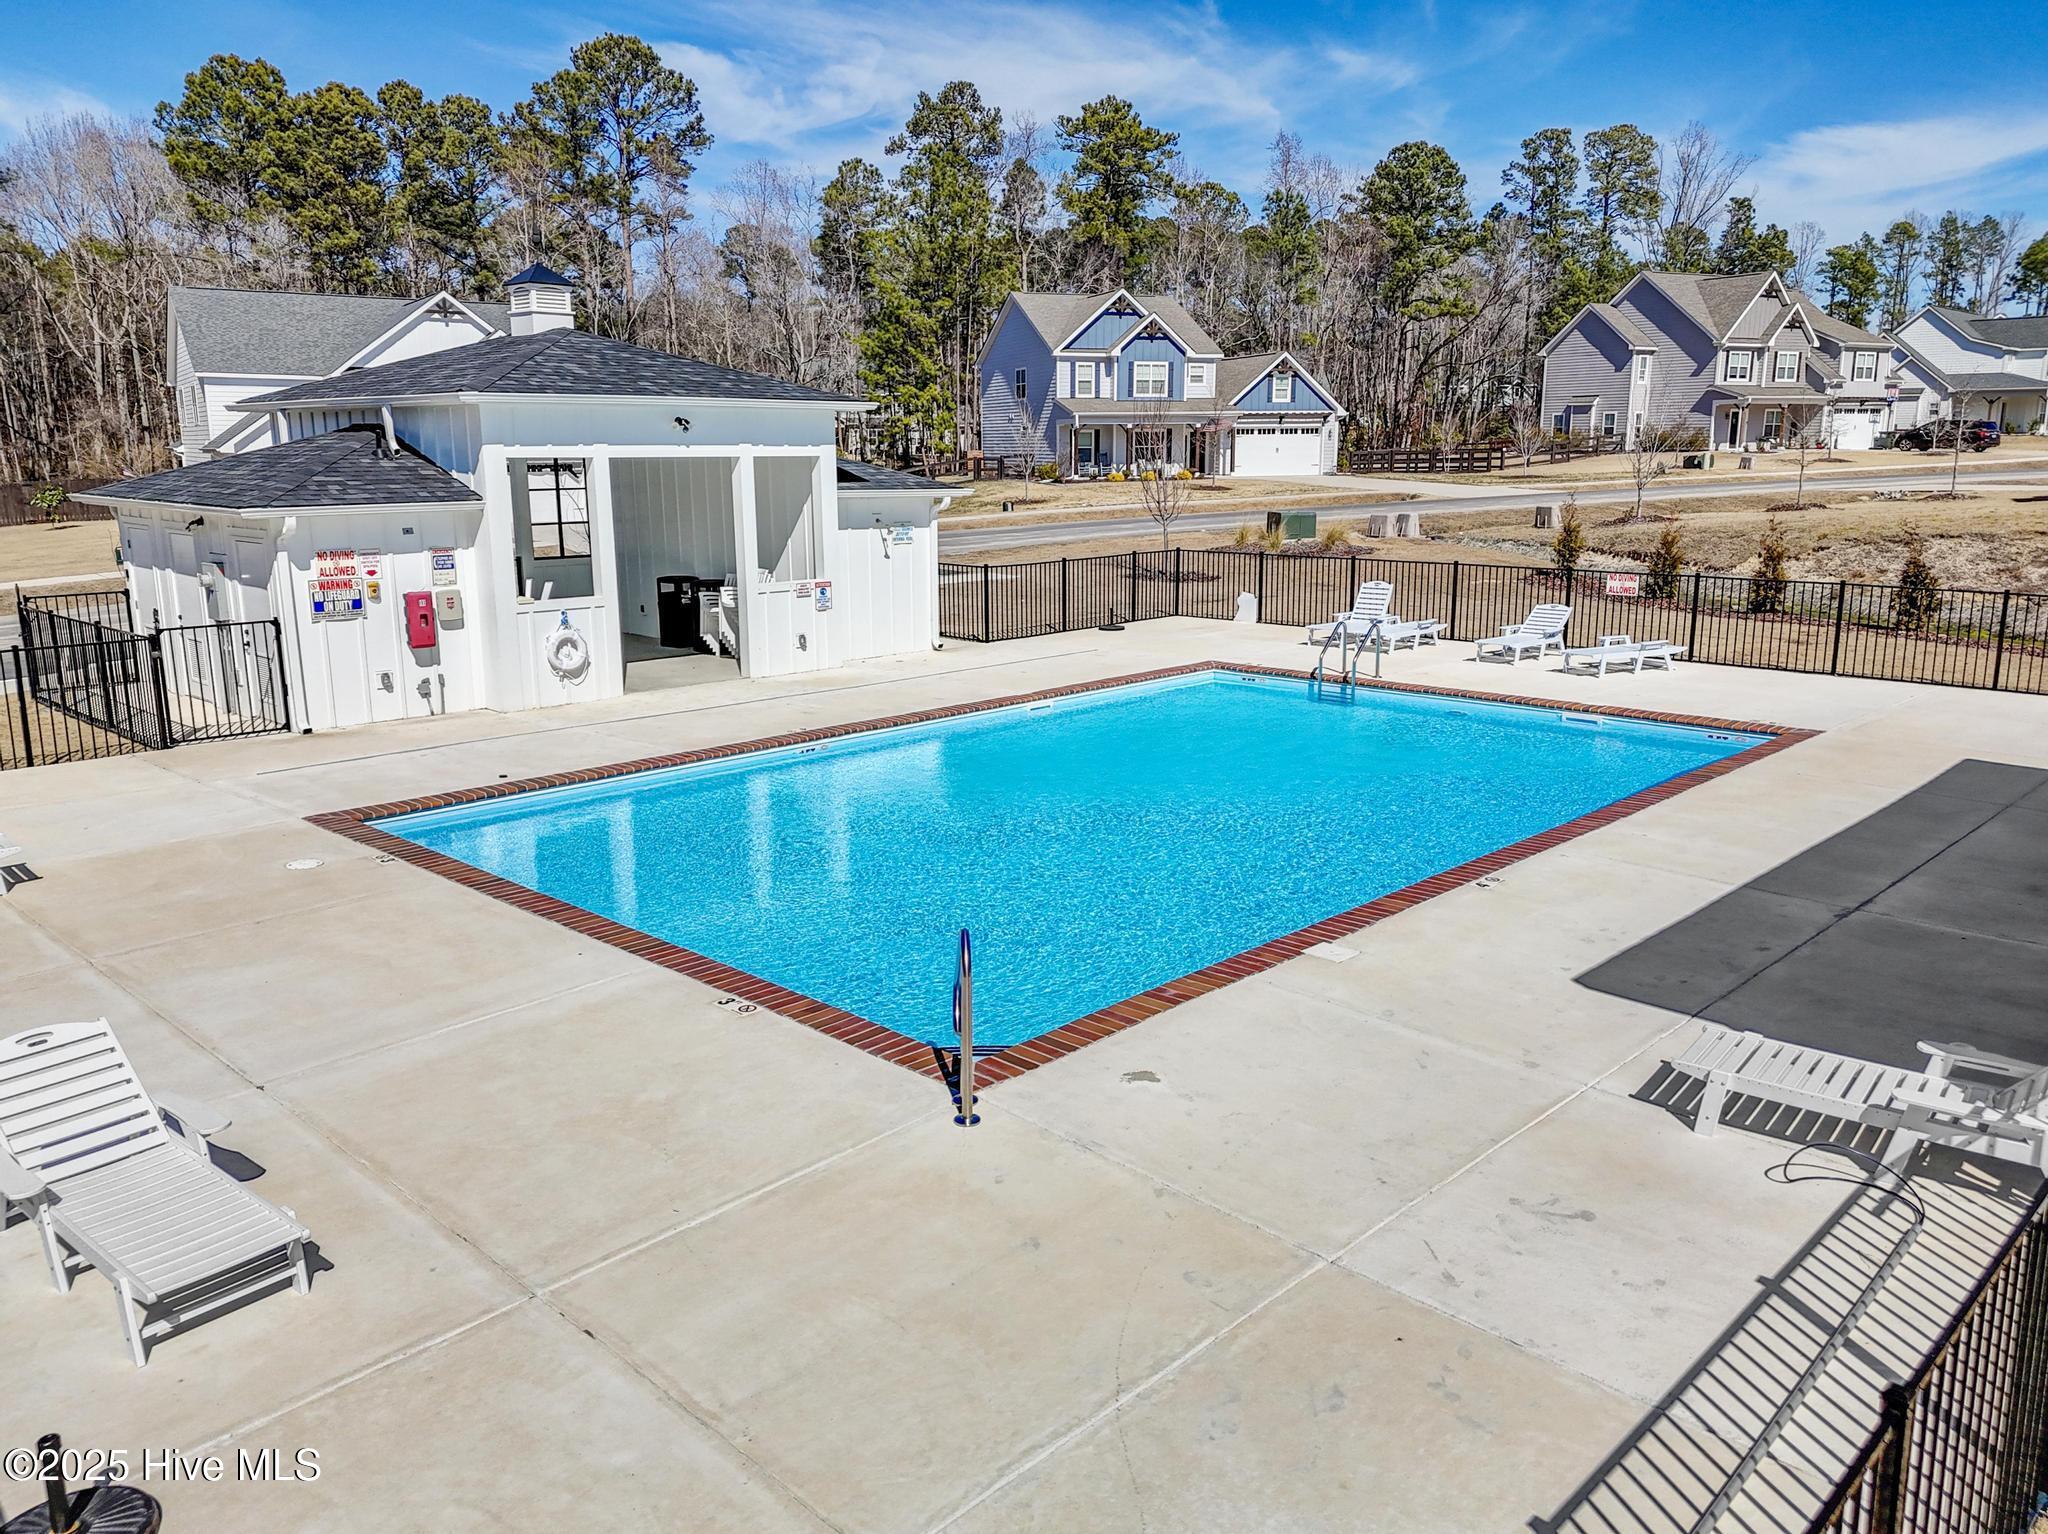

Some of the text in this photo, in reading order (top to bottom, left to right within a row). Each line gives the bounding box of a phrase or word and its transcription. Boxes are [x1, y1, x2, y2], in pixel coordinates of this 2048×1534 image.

[316, 550, 355, 561] NO DIVING
[319, 566, 356, 577] ALLOWED
[1609, 573, 1637, 583] NO DIVING
[318, 580, 353, 591] WARNING
[1608, 586, 1637, 595] ALLOWED
[313, 589, 361, 602] NO LIFEGUARD
[323, 600, 353, 612] ON DUTY
